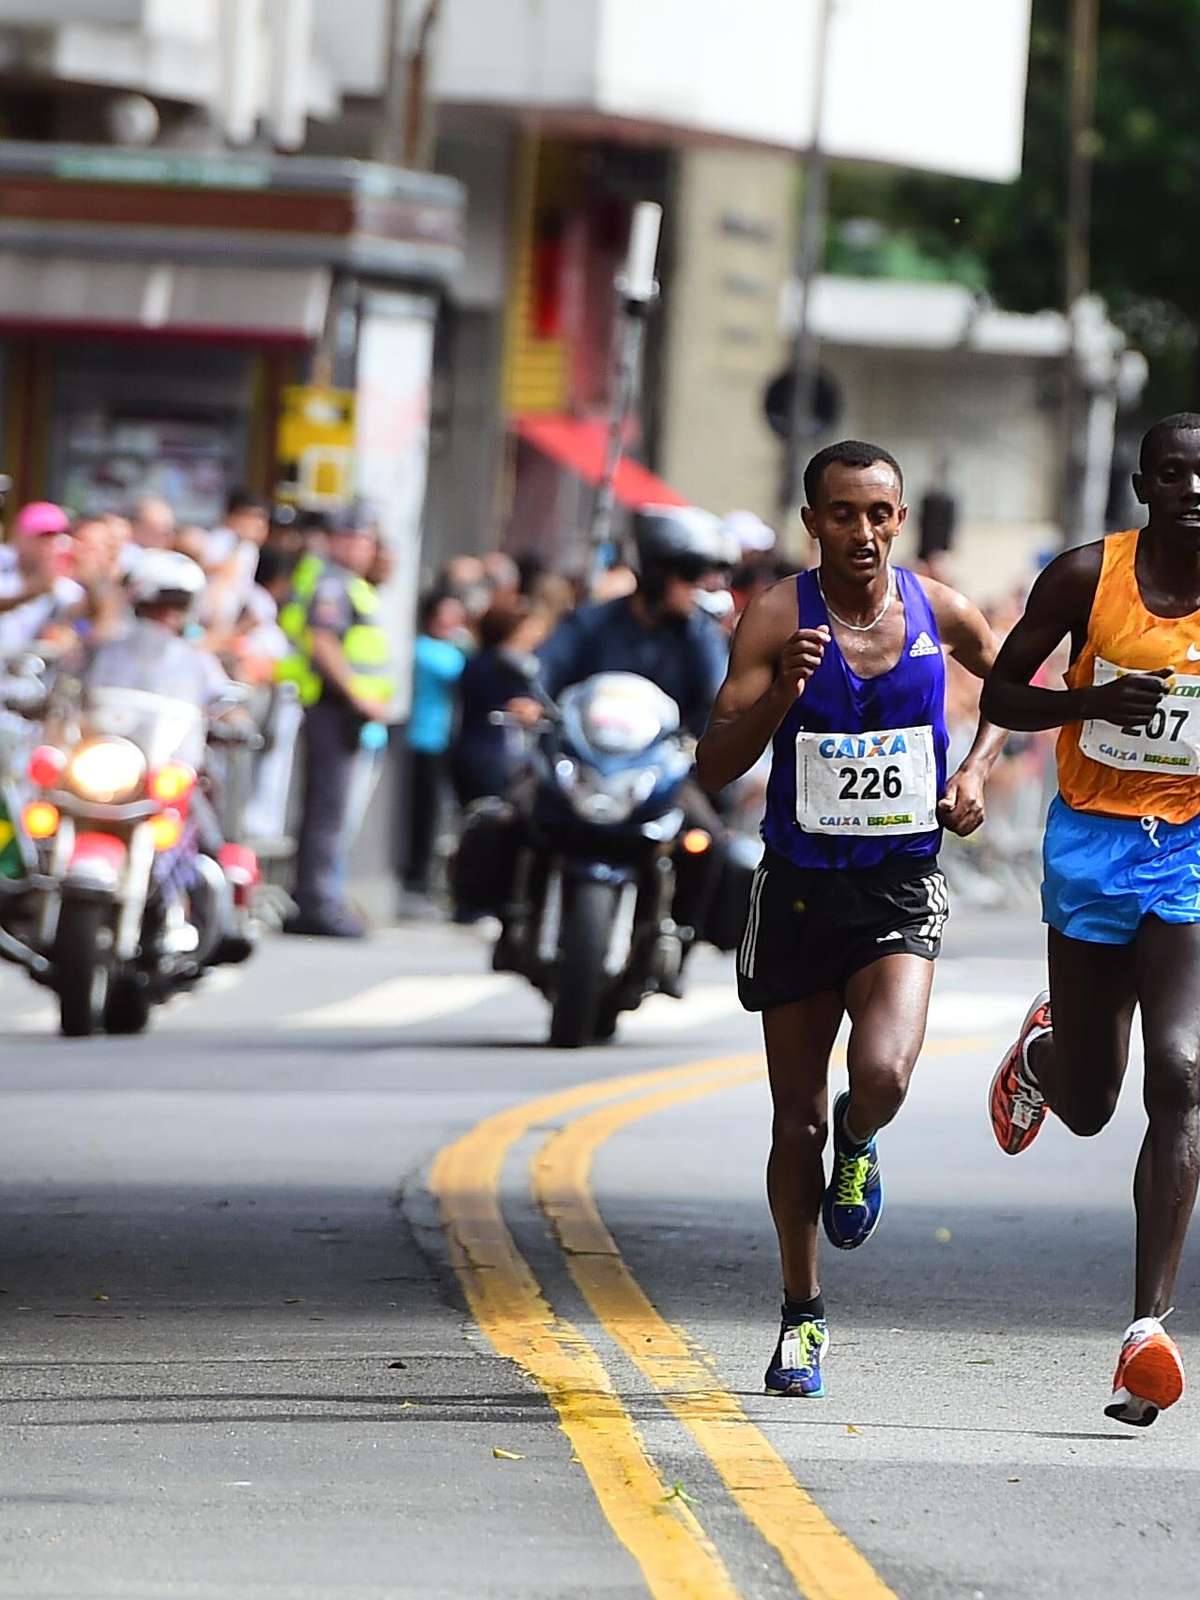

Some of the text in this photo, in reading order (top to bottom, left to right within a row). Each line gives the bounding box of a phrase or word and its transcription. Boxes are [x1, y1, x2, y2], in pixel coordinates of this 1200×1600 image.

[819, 735, 907, 759] CAIXA
[1099, 743, 1190, 767] CAIXA BRASIL
[838, 765, 902, 800] 226
[819, 814, 913, 826] CAIXA BRASIL
